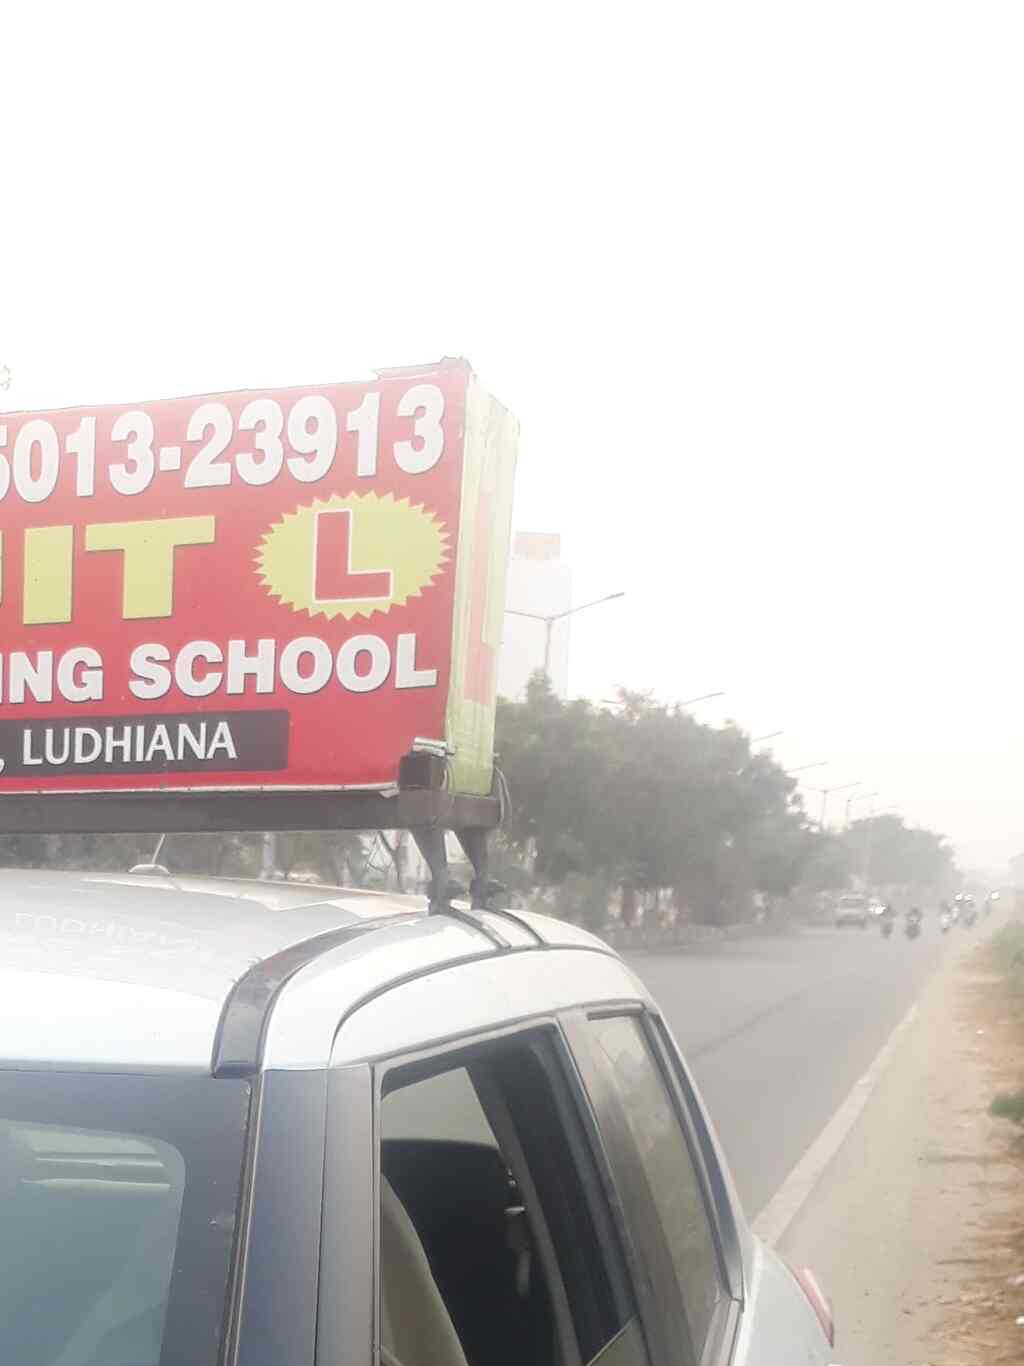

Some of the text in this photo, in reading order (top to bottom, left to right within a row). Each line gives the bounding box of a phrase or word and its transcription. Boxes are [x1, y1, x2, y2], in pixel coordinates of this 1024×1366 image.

[312, 508, 394, 603] L
[128, 633, 438, 699] SCHOOL
[22, 721, 238, 766] LUDHIANA
